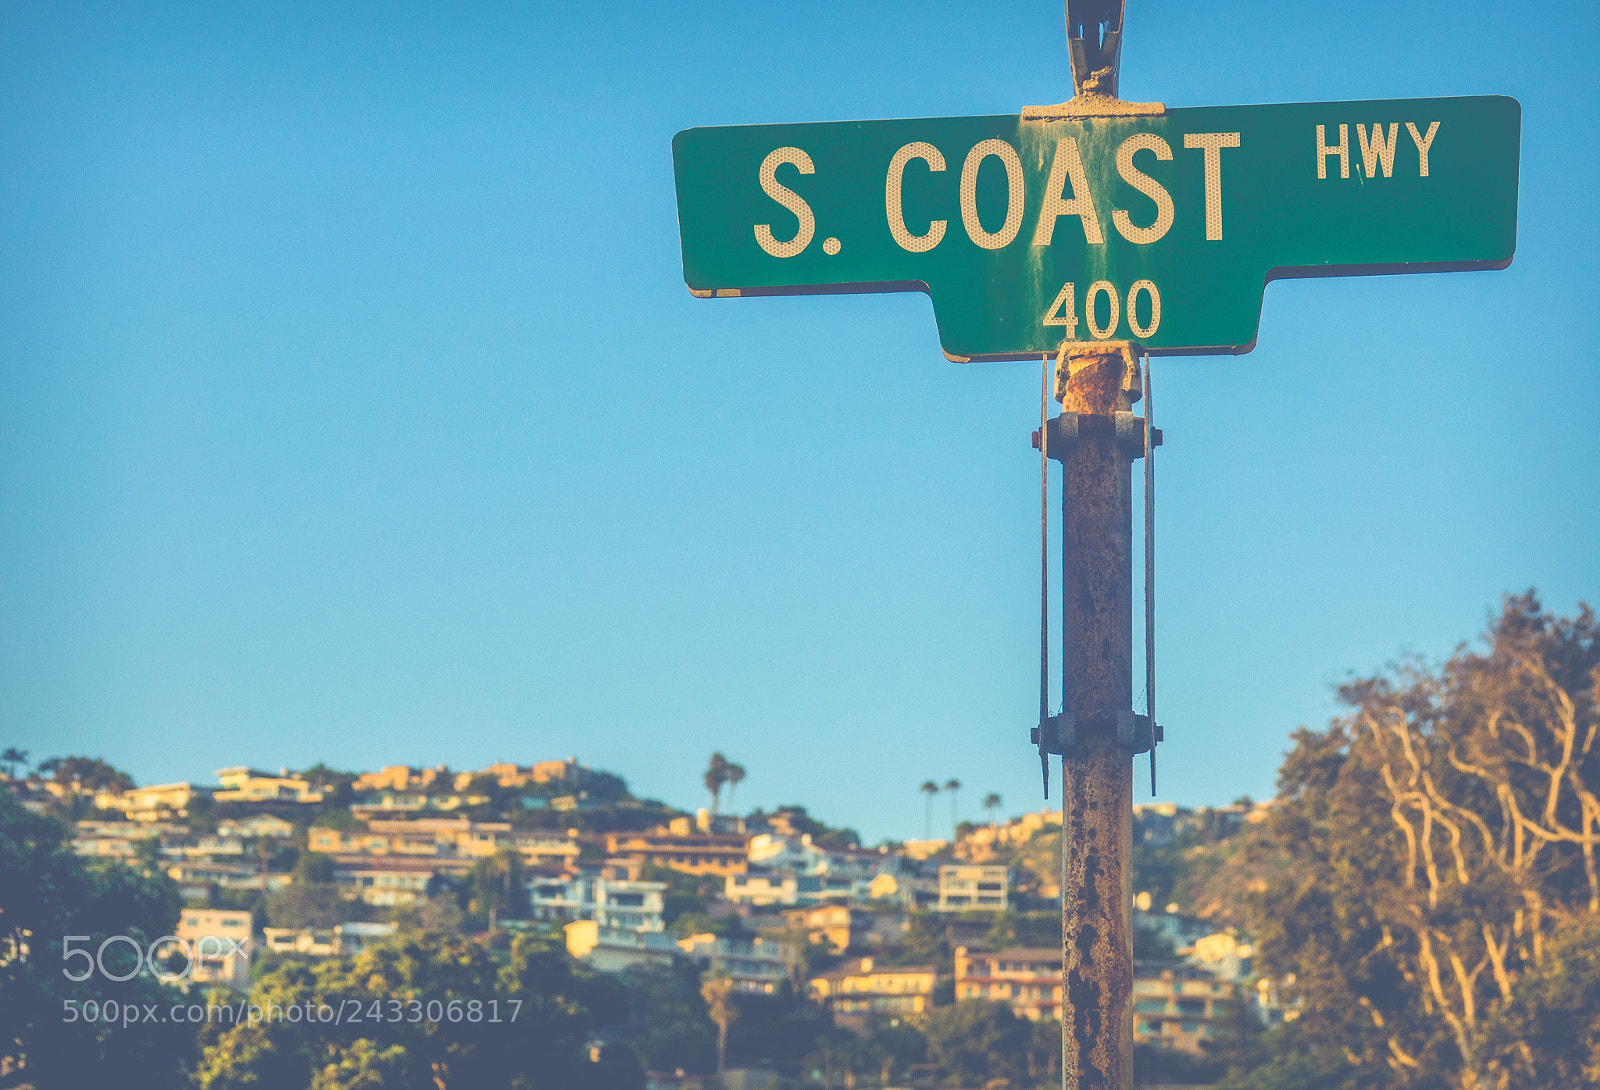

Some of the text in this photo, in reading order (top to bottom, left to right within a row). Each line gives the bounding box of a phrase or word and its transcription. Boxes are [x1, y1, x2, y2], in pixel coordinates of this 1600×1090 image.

[753, 121, 1442, 259] S. COAST HWY
[1042, 279, 1162, 340] 400
